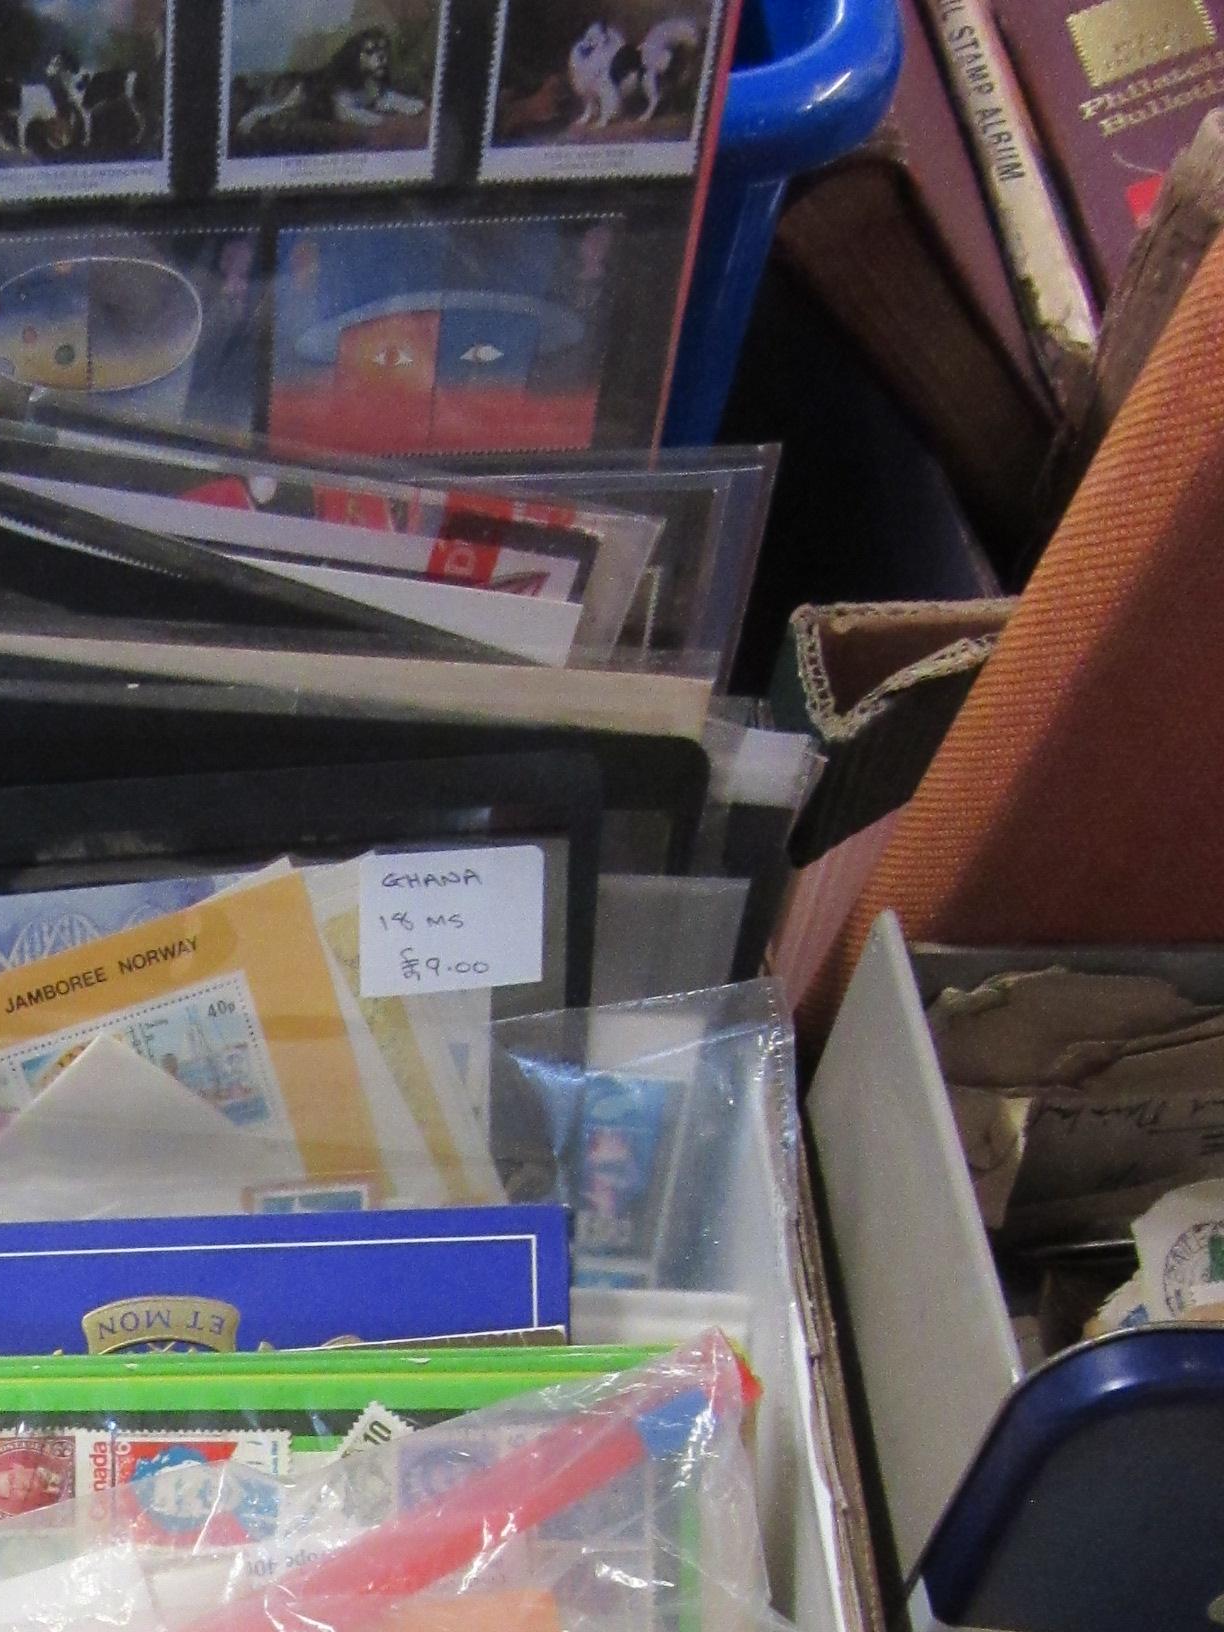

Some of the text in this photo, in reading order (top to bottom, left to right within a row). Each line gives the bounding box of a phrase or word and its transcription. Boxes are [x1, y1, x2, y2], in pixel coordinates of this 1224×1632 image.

[947, 25, 994, 96] STAMP
[381, 868, 482, 889] GHANA
[4, 966, 108, 1014] JAMBOREE
[117, 937, 199, 976] NORWAY
[400, 946, 490, 982] £9.00
[207, 1000, 236, 1018] 40p
[186, 1311, 226, 1336] ET
[363, 1420, 392, 1445] 10
